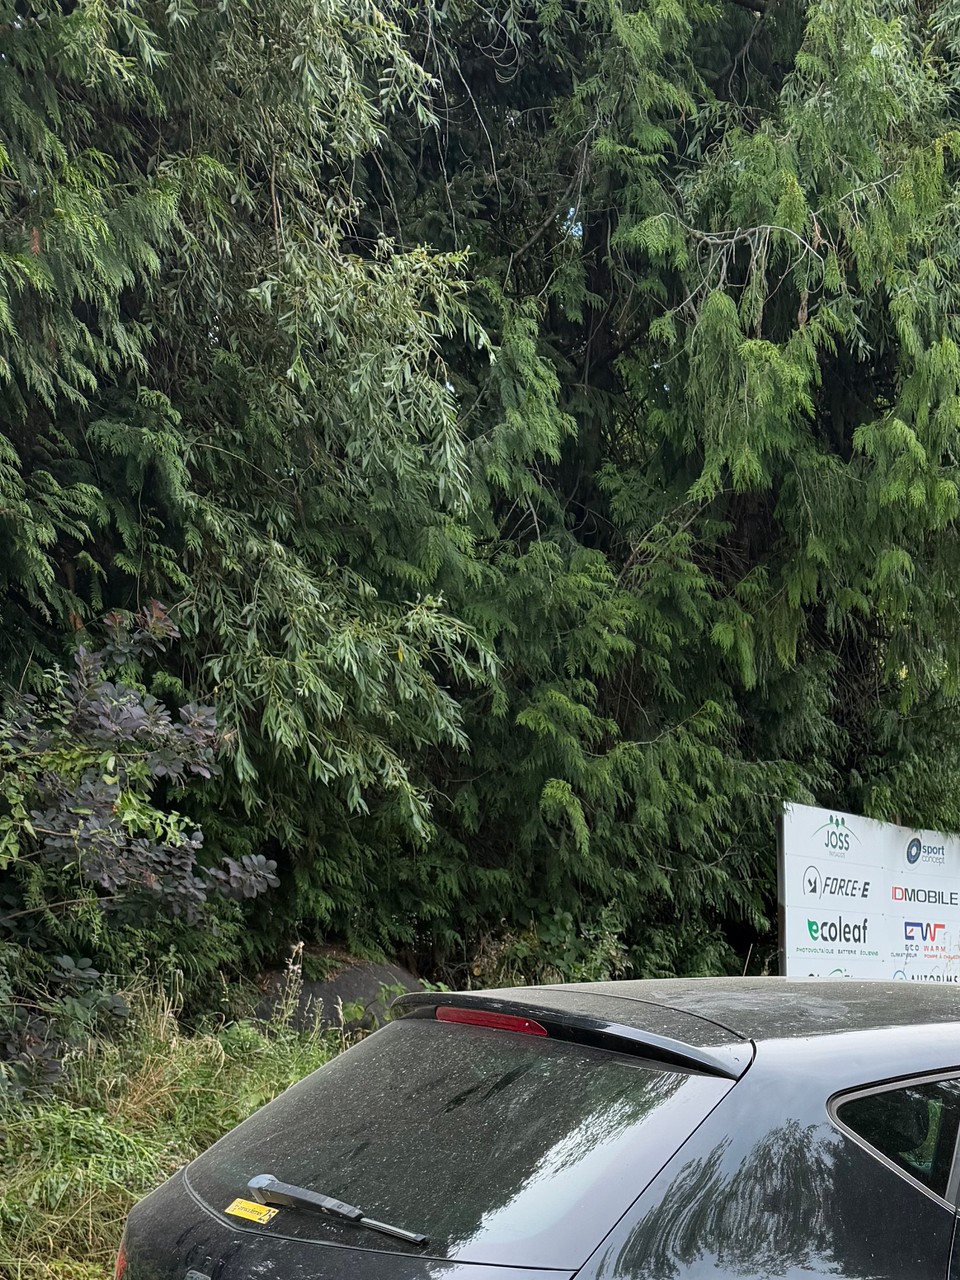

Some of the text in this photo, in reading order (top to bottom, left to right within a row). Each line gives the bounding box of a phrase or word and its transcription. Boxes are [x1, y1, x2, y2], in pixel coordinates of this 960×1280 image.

[824, 830, 850, 851] JOSS
[922, 845, 945, 856] sport
[922, 855, 945, 866] concept
[891, 886, 959, 906] IDMOBILE
[807, 915, 868, 944] ecoleaf
